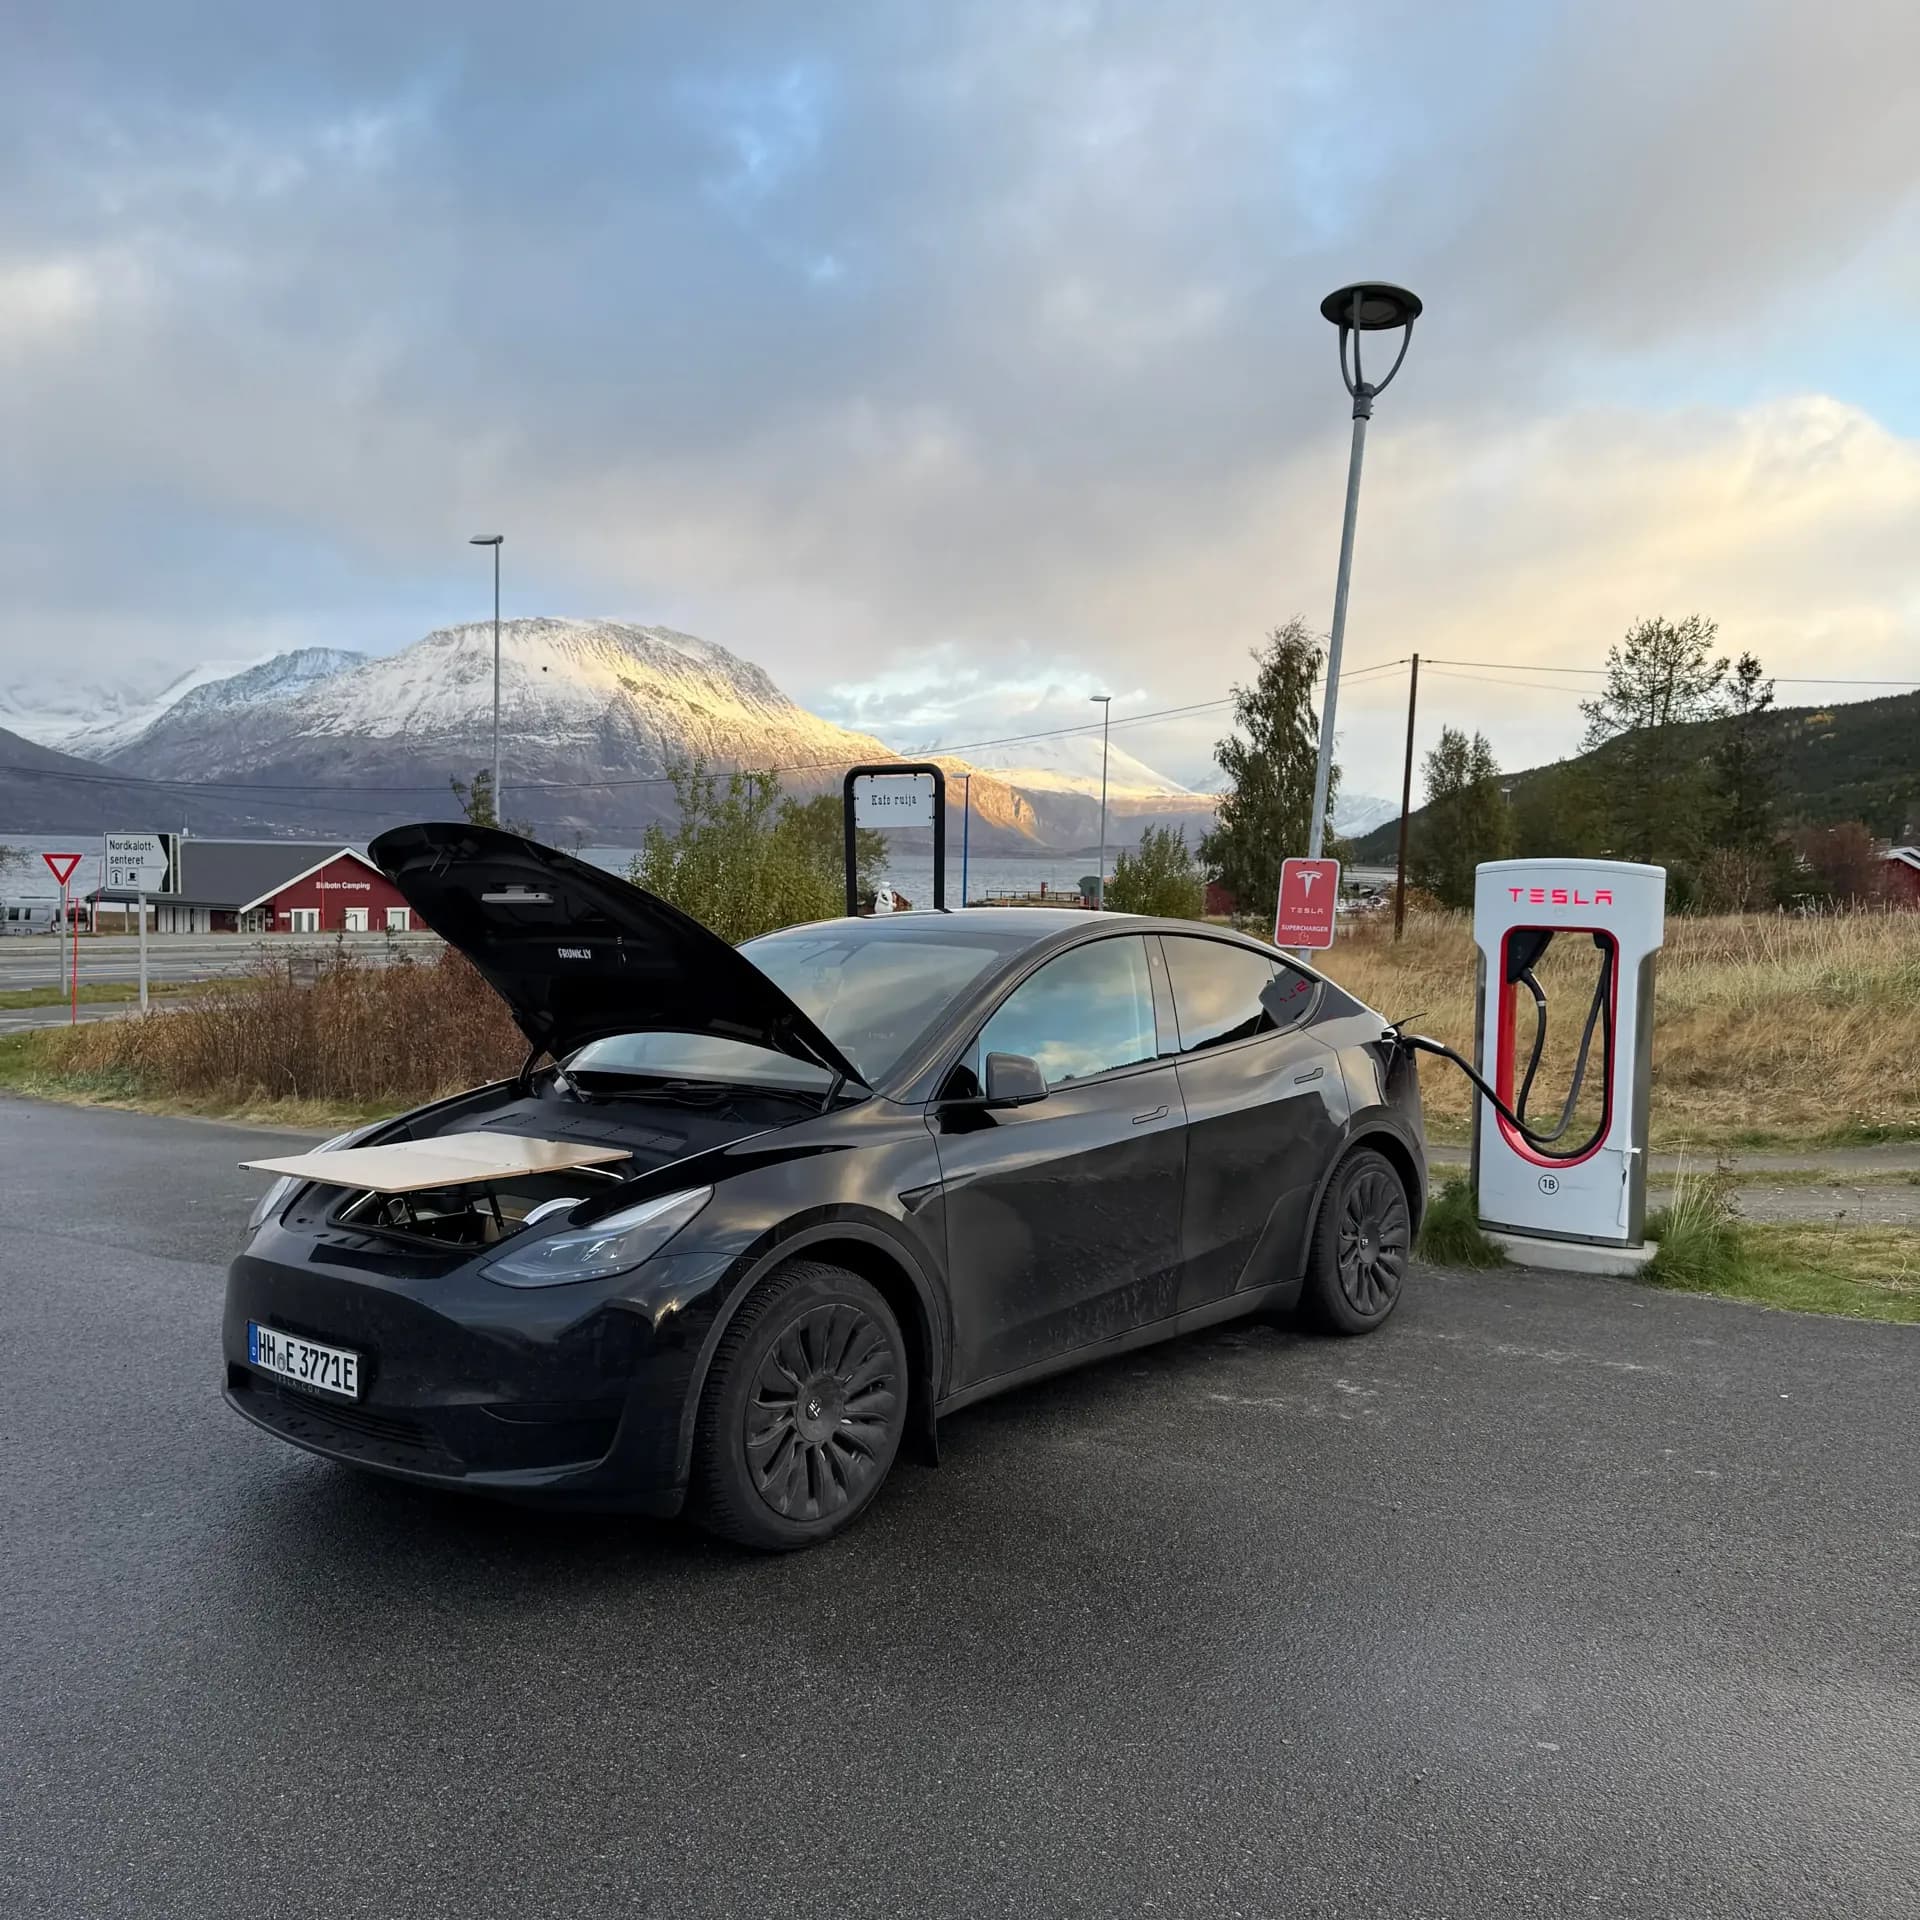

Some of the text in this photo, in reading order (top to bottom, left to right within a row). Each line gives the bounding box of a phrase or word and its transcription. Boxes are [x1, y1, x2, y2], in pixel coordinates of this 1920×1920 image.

[109, 840, 155, 851] Nordkalott-
[110, 855, 144, 865] senteret
[342, 881, 370, 891] Camping
[1508, 888, 1612, 905] TESLA
[1281, 924, 1329, 932] SUPERCHARGER
[1543, 1179, 1555, 1189] 1B
[258, 1331, 275, 1367] HH
